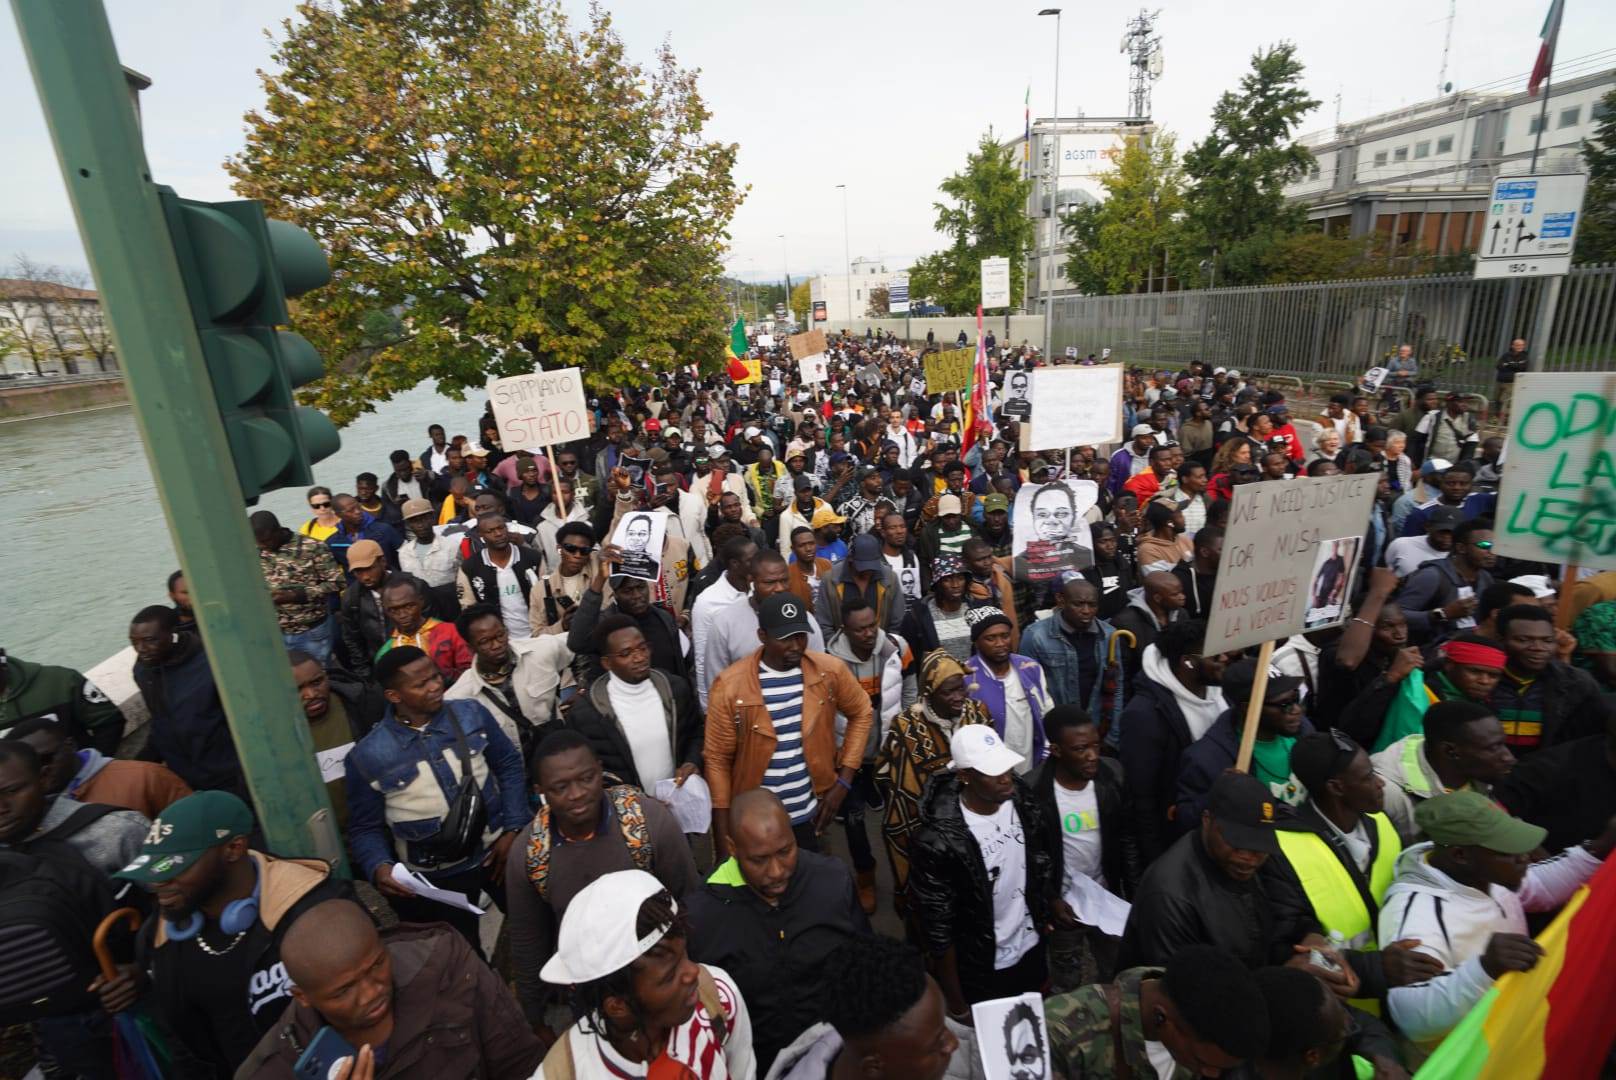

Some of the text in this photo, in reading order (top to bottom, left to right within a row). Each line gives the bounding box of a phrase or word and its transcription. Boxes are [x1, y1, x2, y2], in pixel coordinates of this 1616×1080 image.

[1508, 263, 1527, 273] 150
[925, 348, 970, 371] NEVER
[495, 376, 574, 405] SAPPIAMO
[504, 410, 581, 443] STATO
[1233, 478, 1367, 526] WE NEED JUSTICE
[1227, 527, 1322, 577] FOR MUSA
[1219, 585, 1251, 612] NOUS
[1224, 616, 1242, 639] LA
